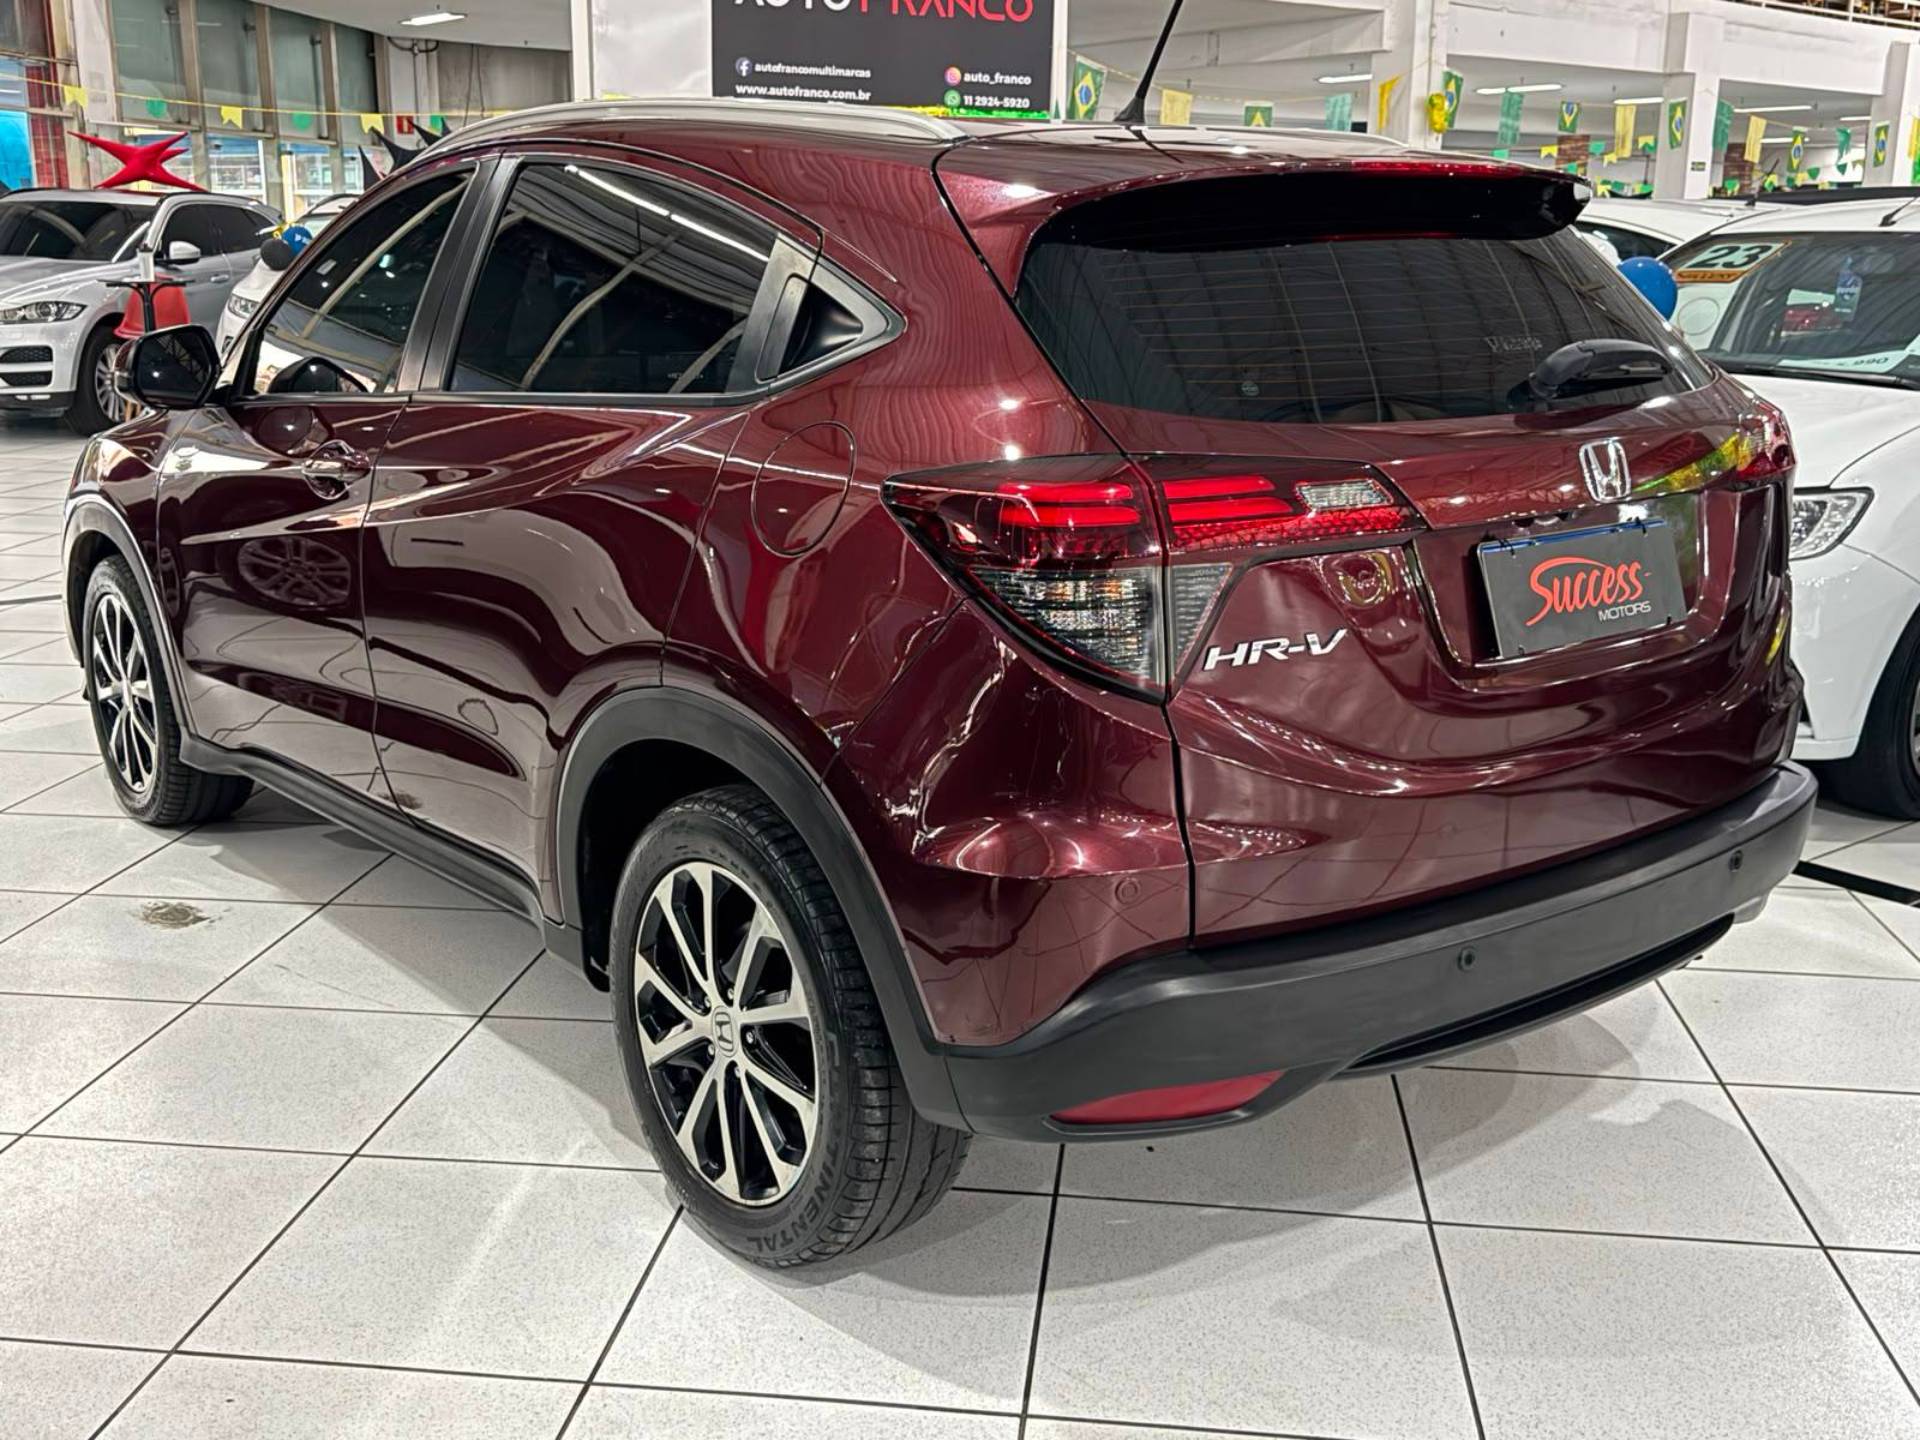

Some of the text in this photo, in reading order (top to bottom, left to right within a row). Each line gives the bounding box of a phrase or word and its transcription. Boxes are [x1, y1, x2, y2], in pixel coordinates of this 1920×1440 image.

[754, 62, 871, 78] autofrancomultimarcas
[963, 72, 1032, 85] auto_franco
[735, 84, 871, 100] www.autofranco.com.br
[963, 95, 973, 106] 11
[1684, 246, 1774, 269] 23
[1598, 601, 1652, 622] MOTORS
[1203, 628, 1348, 671] HR-V
